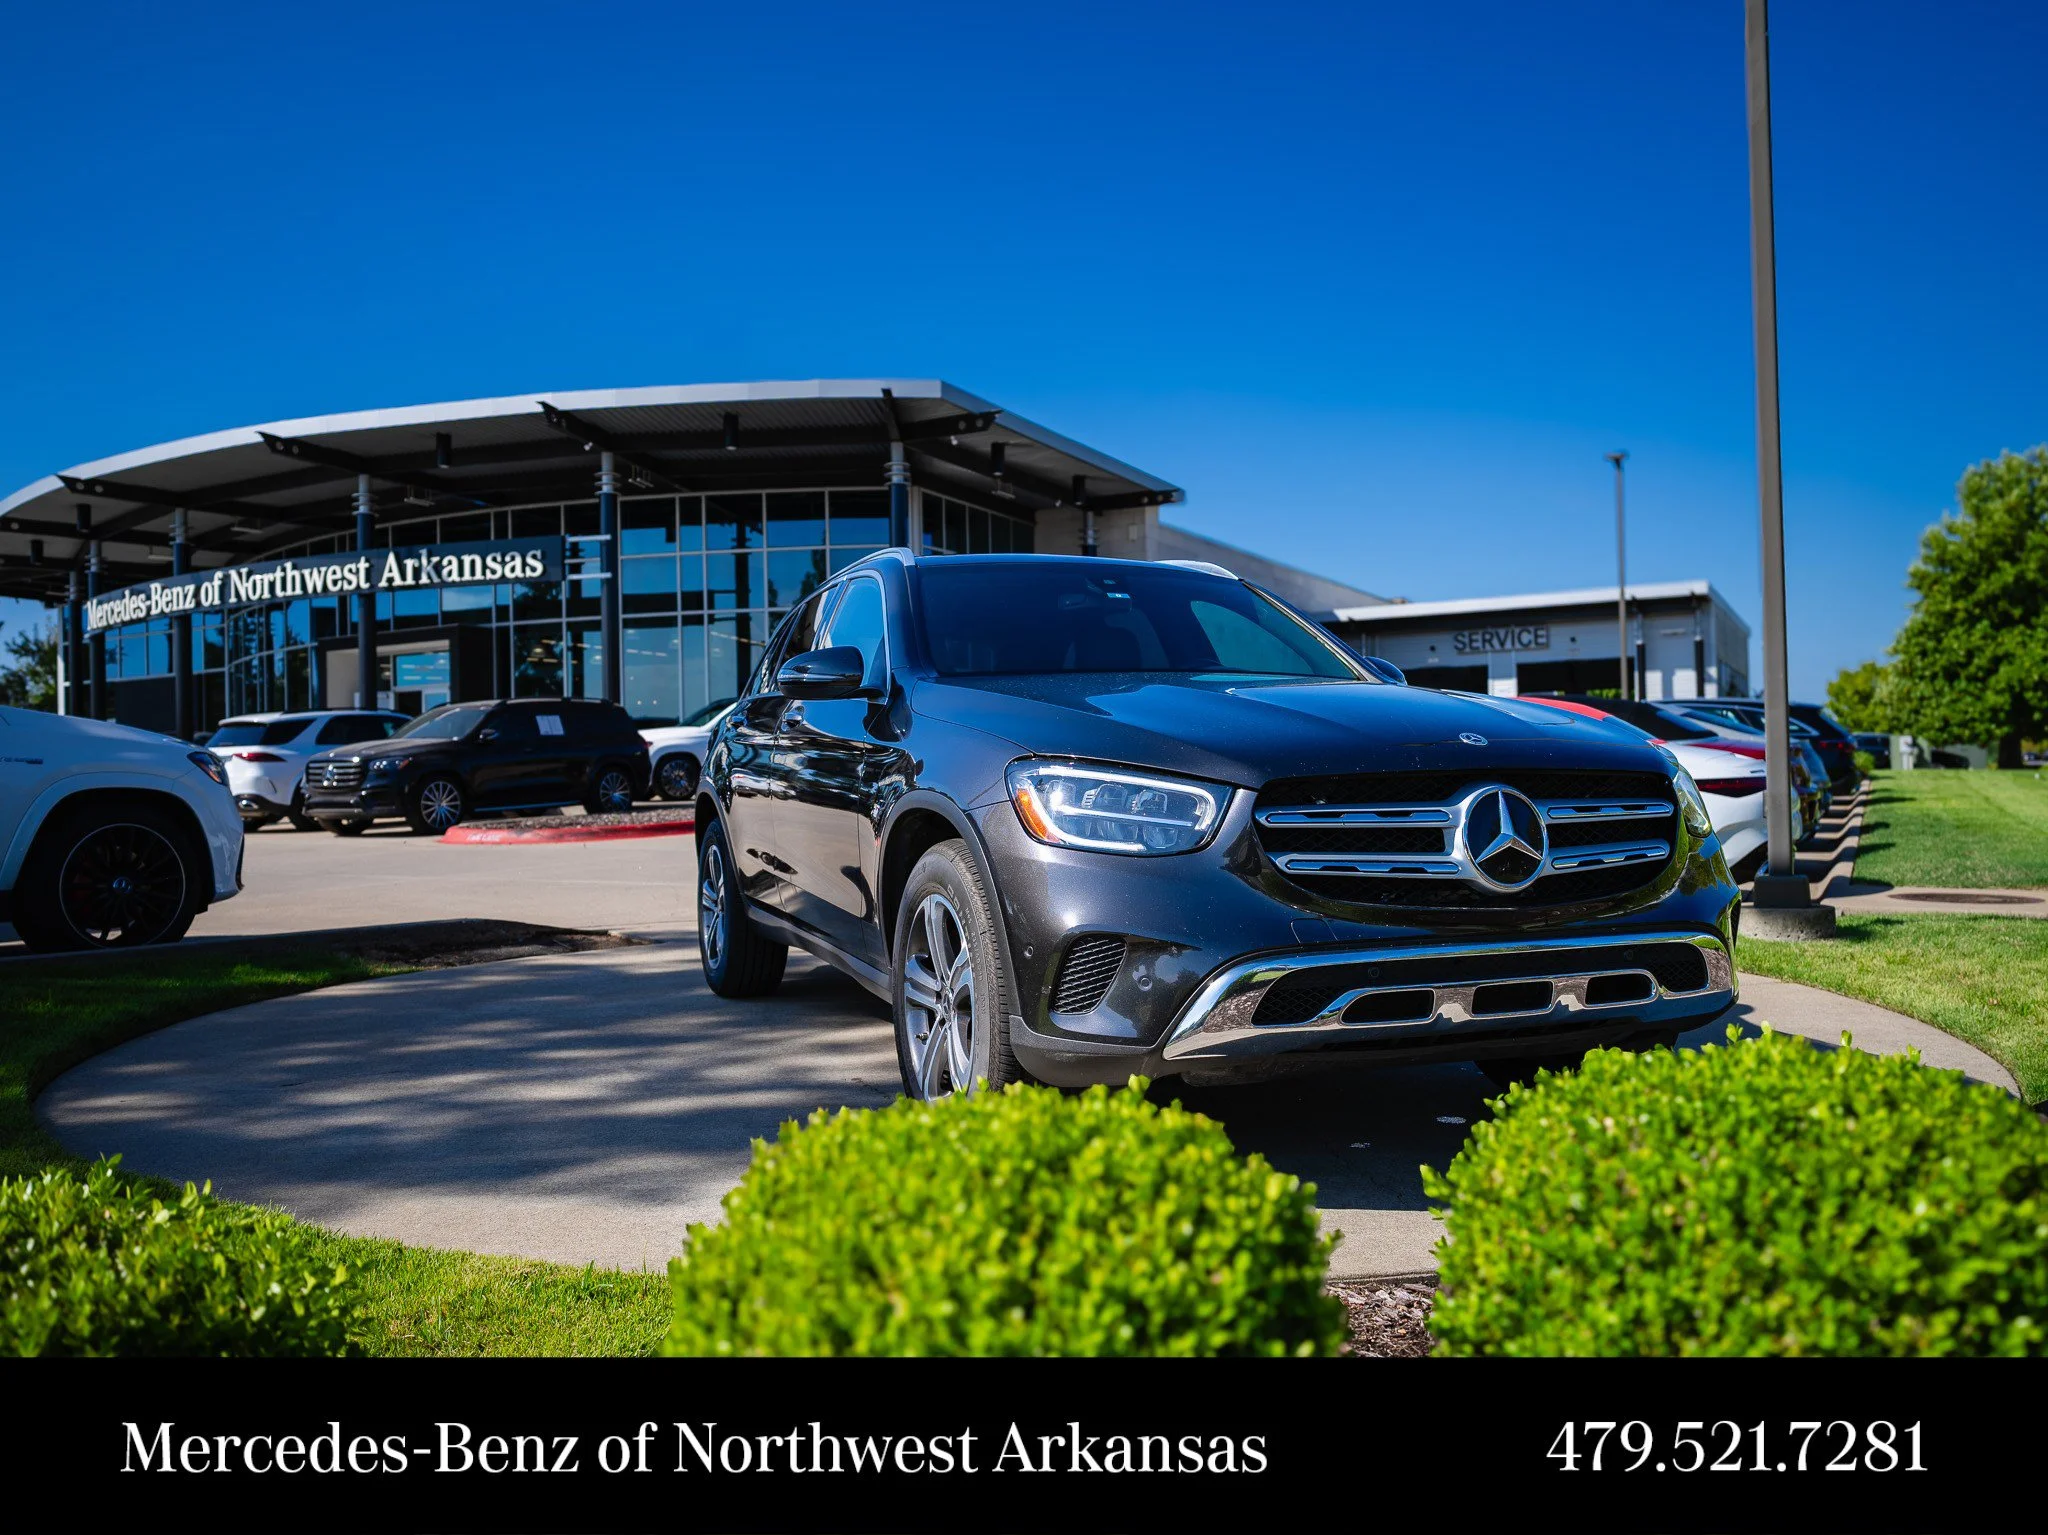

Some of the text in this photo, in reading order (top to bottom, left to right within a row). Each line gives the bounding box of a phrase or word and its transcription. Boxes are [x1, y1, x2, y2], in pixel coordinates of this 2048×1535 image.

[85, 548, 545, 631] Mercedes-Benz of Northwest Arkansas
[1453, 627, 1546, 651] SERVICE
